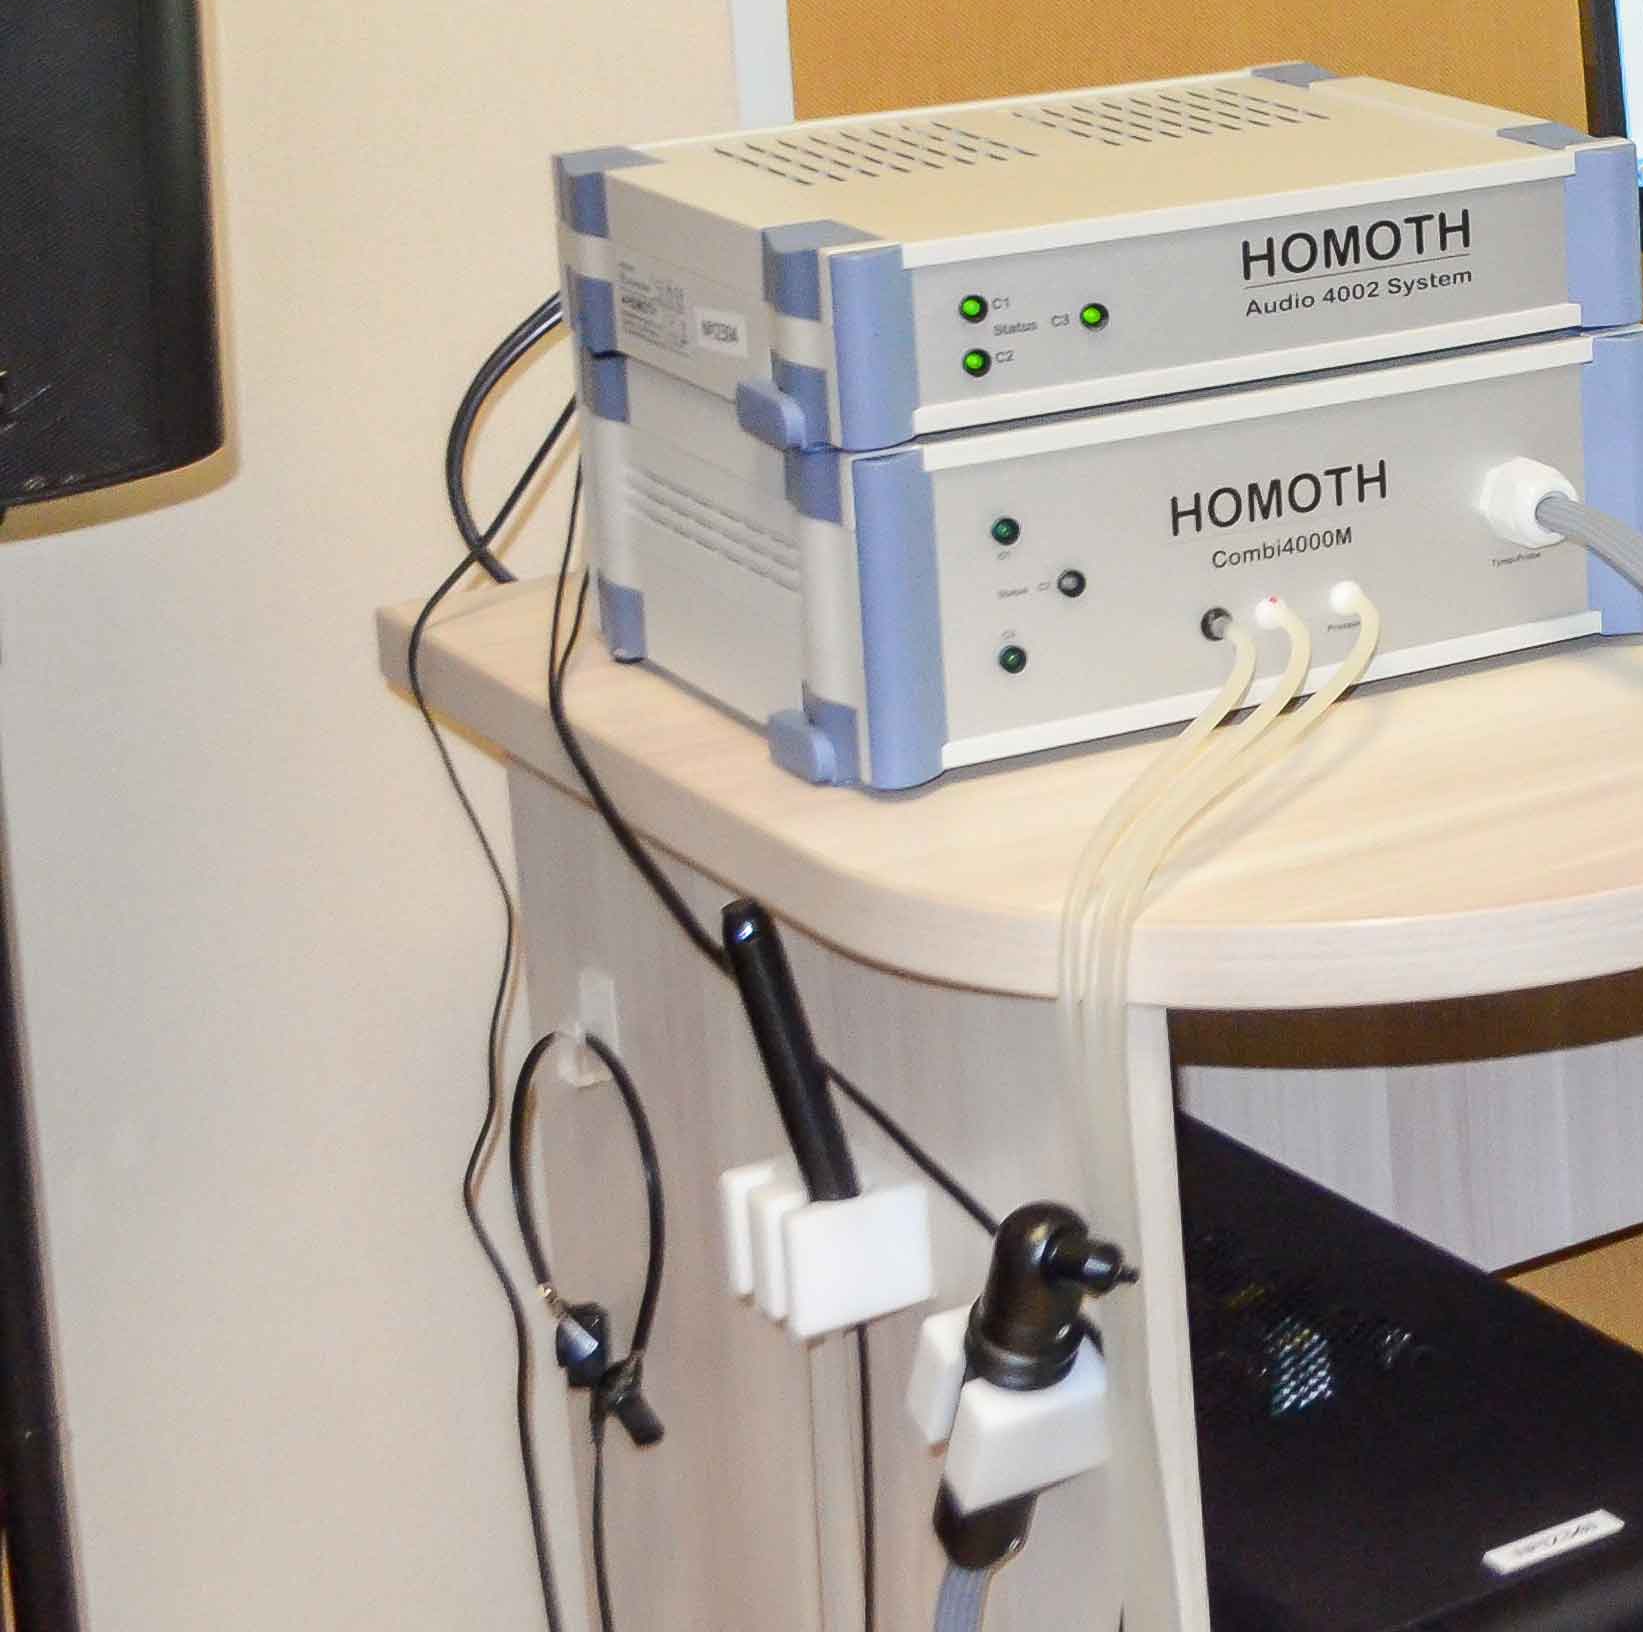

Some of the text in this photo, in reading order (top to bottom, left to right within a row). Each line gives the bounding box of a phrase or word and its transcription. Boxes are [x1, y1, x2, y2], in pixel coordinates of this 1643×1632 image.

[1241, 208, 1471, 281] HOMOTH
[991, 297, 1010, 310] C1
[1245, 269, 1473, 317] Audio 4002 System
[993, 321, 1038, 336] Status
[1051, 313, 1070, 327] C3
[995, 350, 1015, 363] C2
[1170, 459, 1387, 536] HOMOTH
[1211, 526, 1353, 569] Combi4000M
